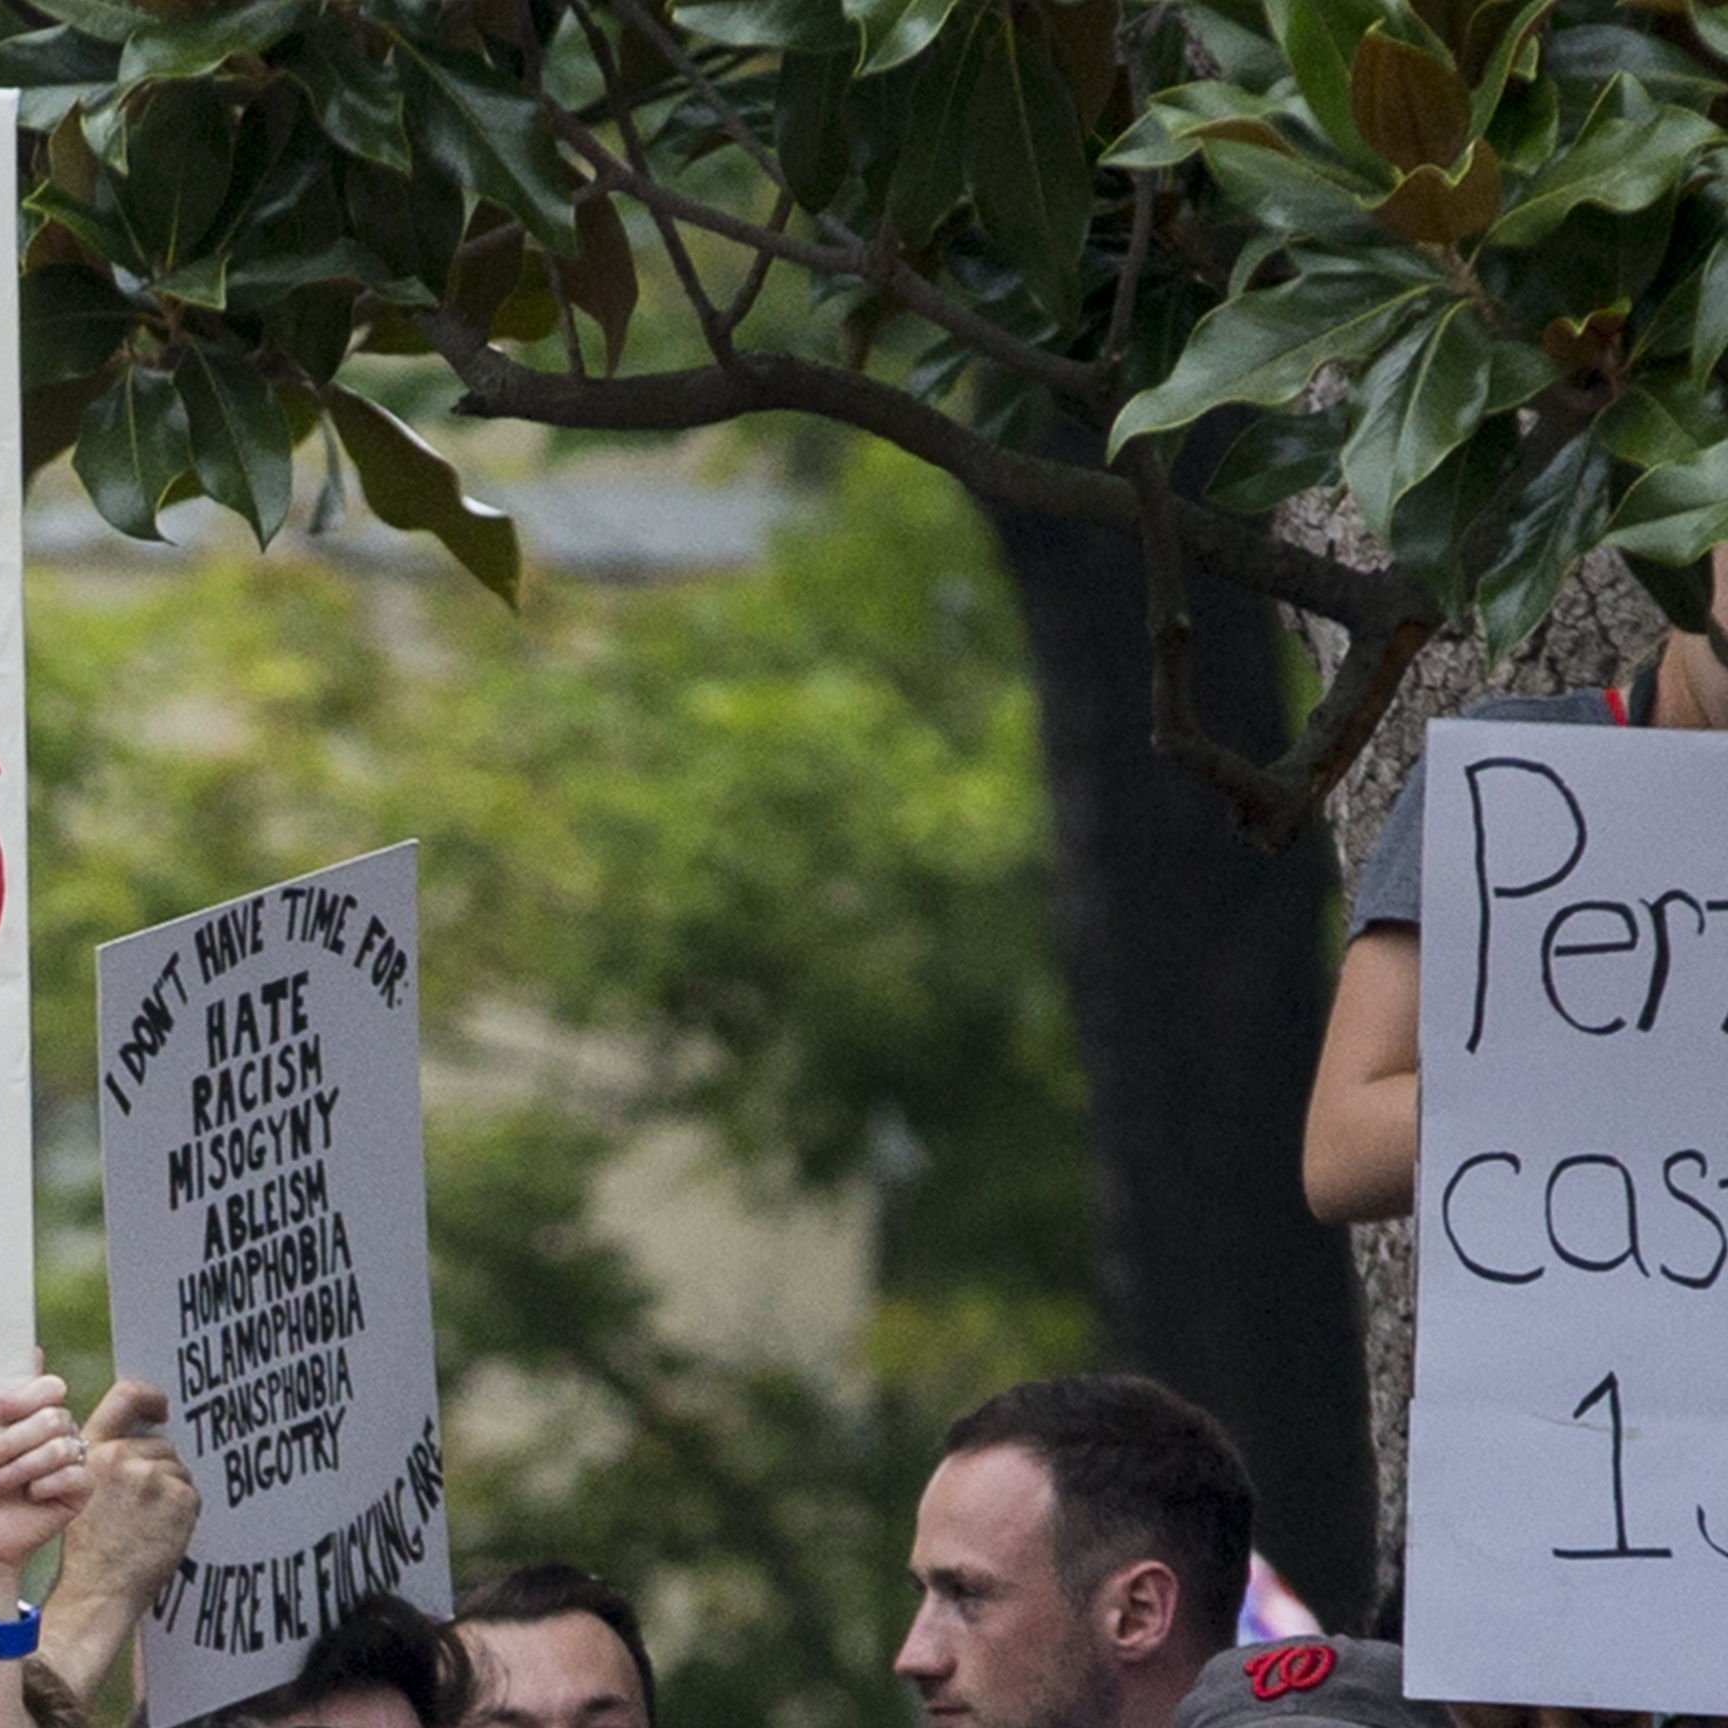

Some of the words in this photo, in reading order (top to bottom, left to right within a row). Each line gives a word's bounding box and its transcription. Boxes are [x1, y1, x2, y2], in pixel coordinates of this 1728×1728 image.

[1464, 755, 1728, 1053] Per
[104, 1072, 131, 1117] I
[118, 951, 189, 1085] DON'T
[194, 896, 265, 985] HAVE
[280, 886, 358, 956] TIME
[353, 914, 411, 1010] FOR:
[205, 970, 310, 1068] HATE
[191, 1033, 324, 1137] RACISM
[168, 1087, 340, 1212] MISOGYNY
[203, 1159, 329, 1262] ABLEISM
[178, 1211, 353, 1338] HOMOPHOBIA
[1442, 1148, 1728, 1290] cas
[177, 1273, 366, 1403] ISLAMOPHOBIA
[184, 1347, 354, 1457] TRANSPHOBIA
[224, 1406, 347, 1509] BIGOTRY
[1552, 1371, 1728, 1560] 1
[152, 1556, 199, 1634] UT
[194, 1560, 264, 1656] HERE
[270, 1550, 310, 1644] WE
[313, 1477, 425, 1635] FUCKING
